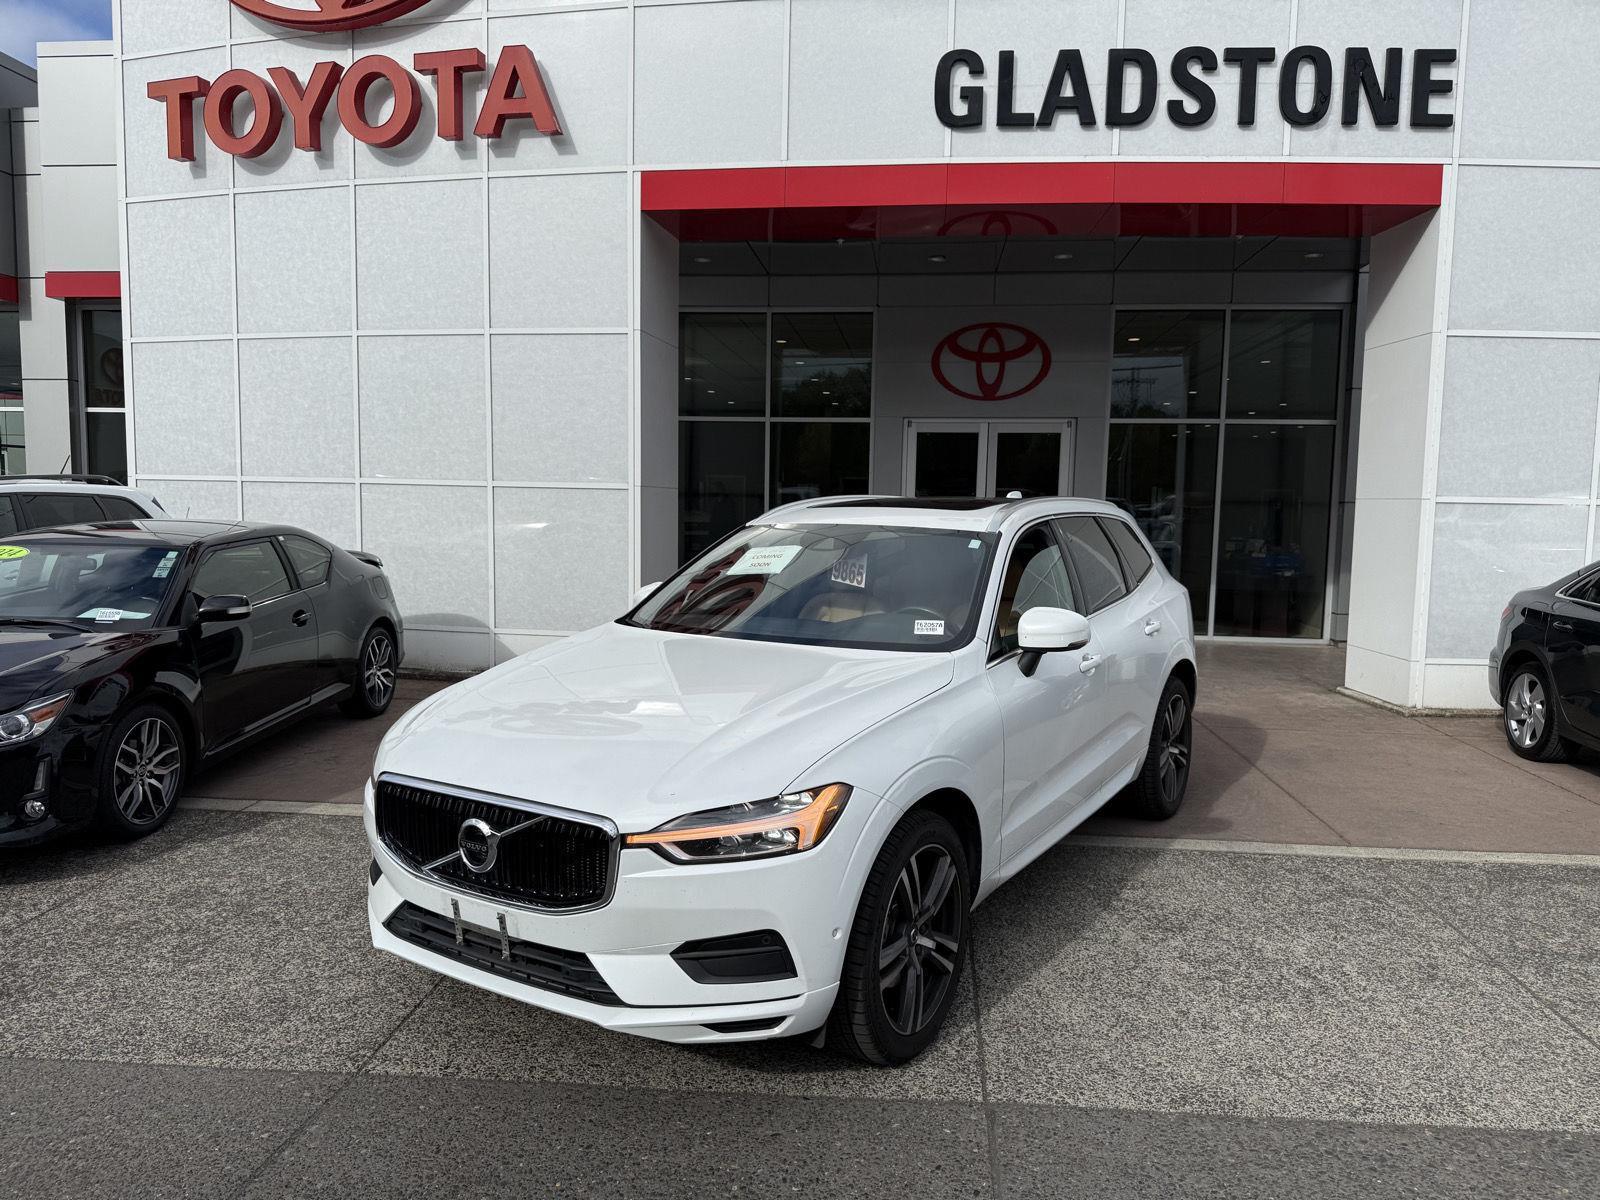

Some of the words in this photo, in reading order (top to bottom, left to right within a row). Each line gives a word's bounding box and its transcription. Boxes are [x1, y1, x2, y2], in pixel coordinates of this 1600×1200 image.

[147, 44, 563, 162] TOYOTA
[934, 45, 1456, 128] GLADSTONE
[833, 560, 865, 586] 9865
[460, 840, 488, 852] VOLVO
